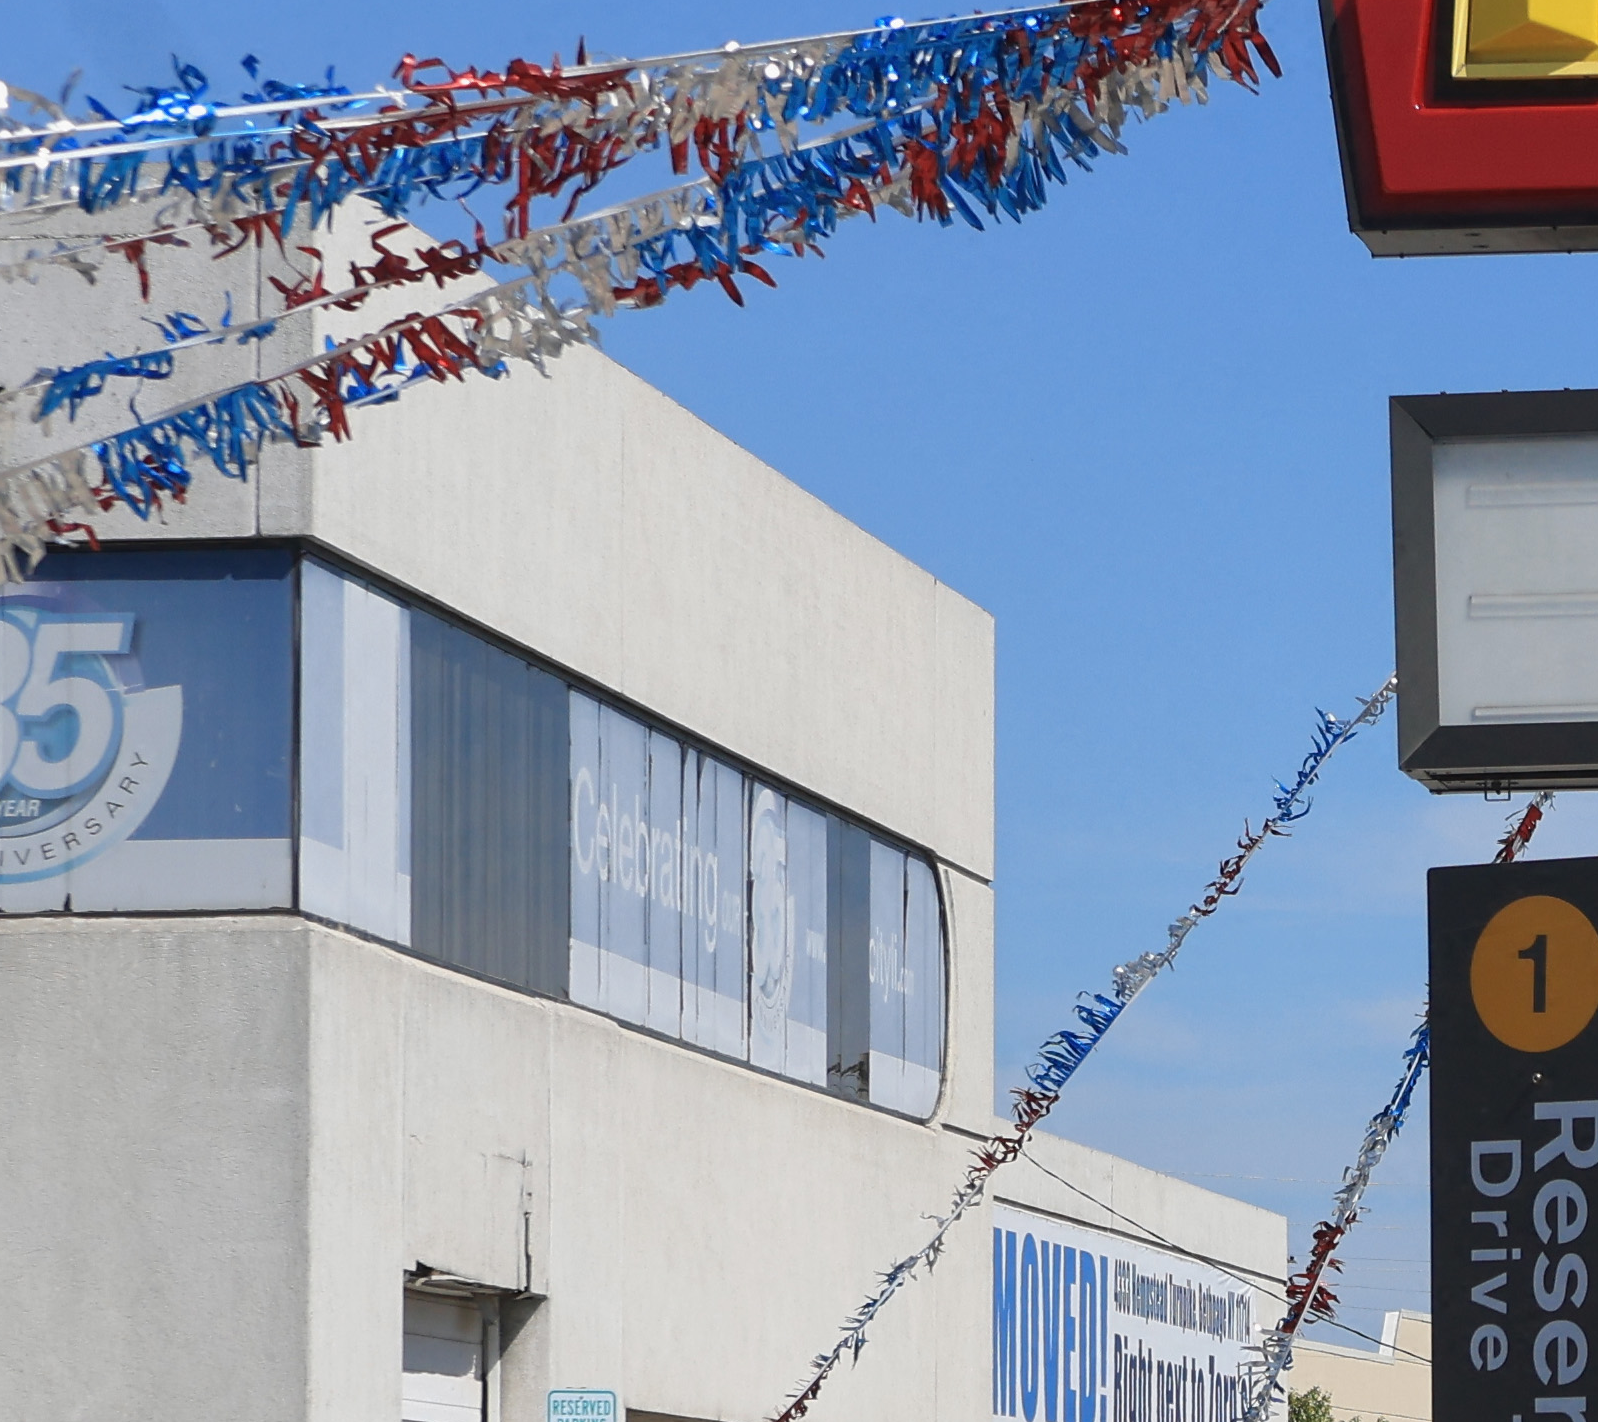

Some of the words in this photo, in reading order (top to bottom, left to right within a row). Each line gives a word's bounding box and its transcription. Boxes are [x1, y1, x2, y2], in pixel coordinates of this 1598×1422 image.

[571, 767, 719, 953] Celebrating
[1517, 934, 1548, 1013] 1
[1470, 1140, 1521, 1371] Drive
[553, 1399, 611, 1415] RESERVED
